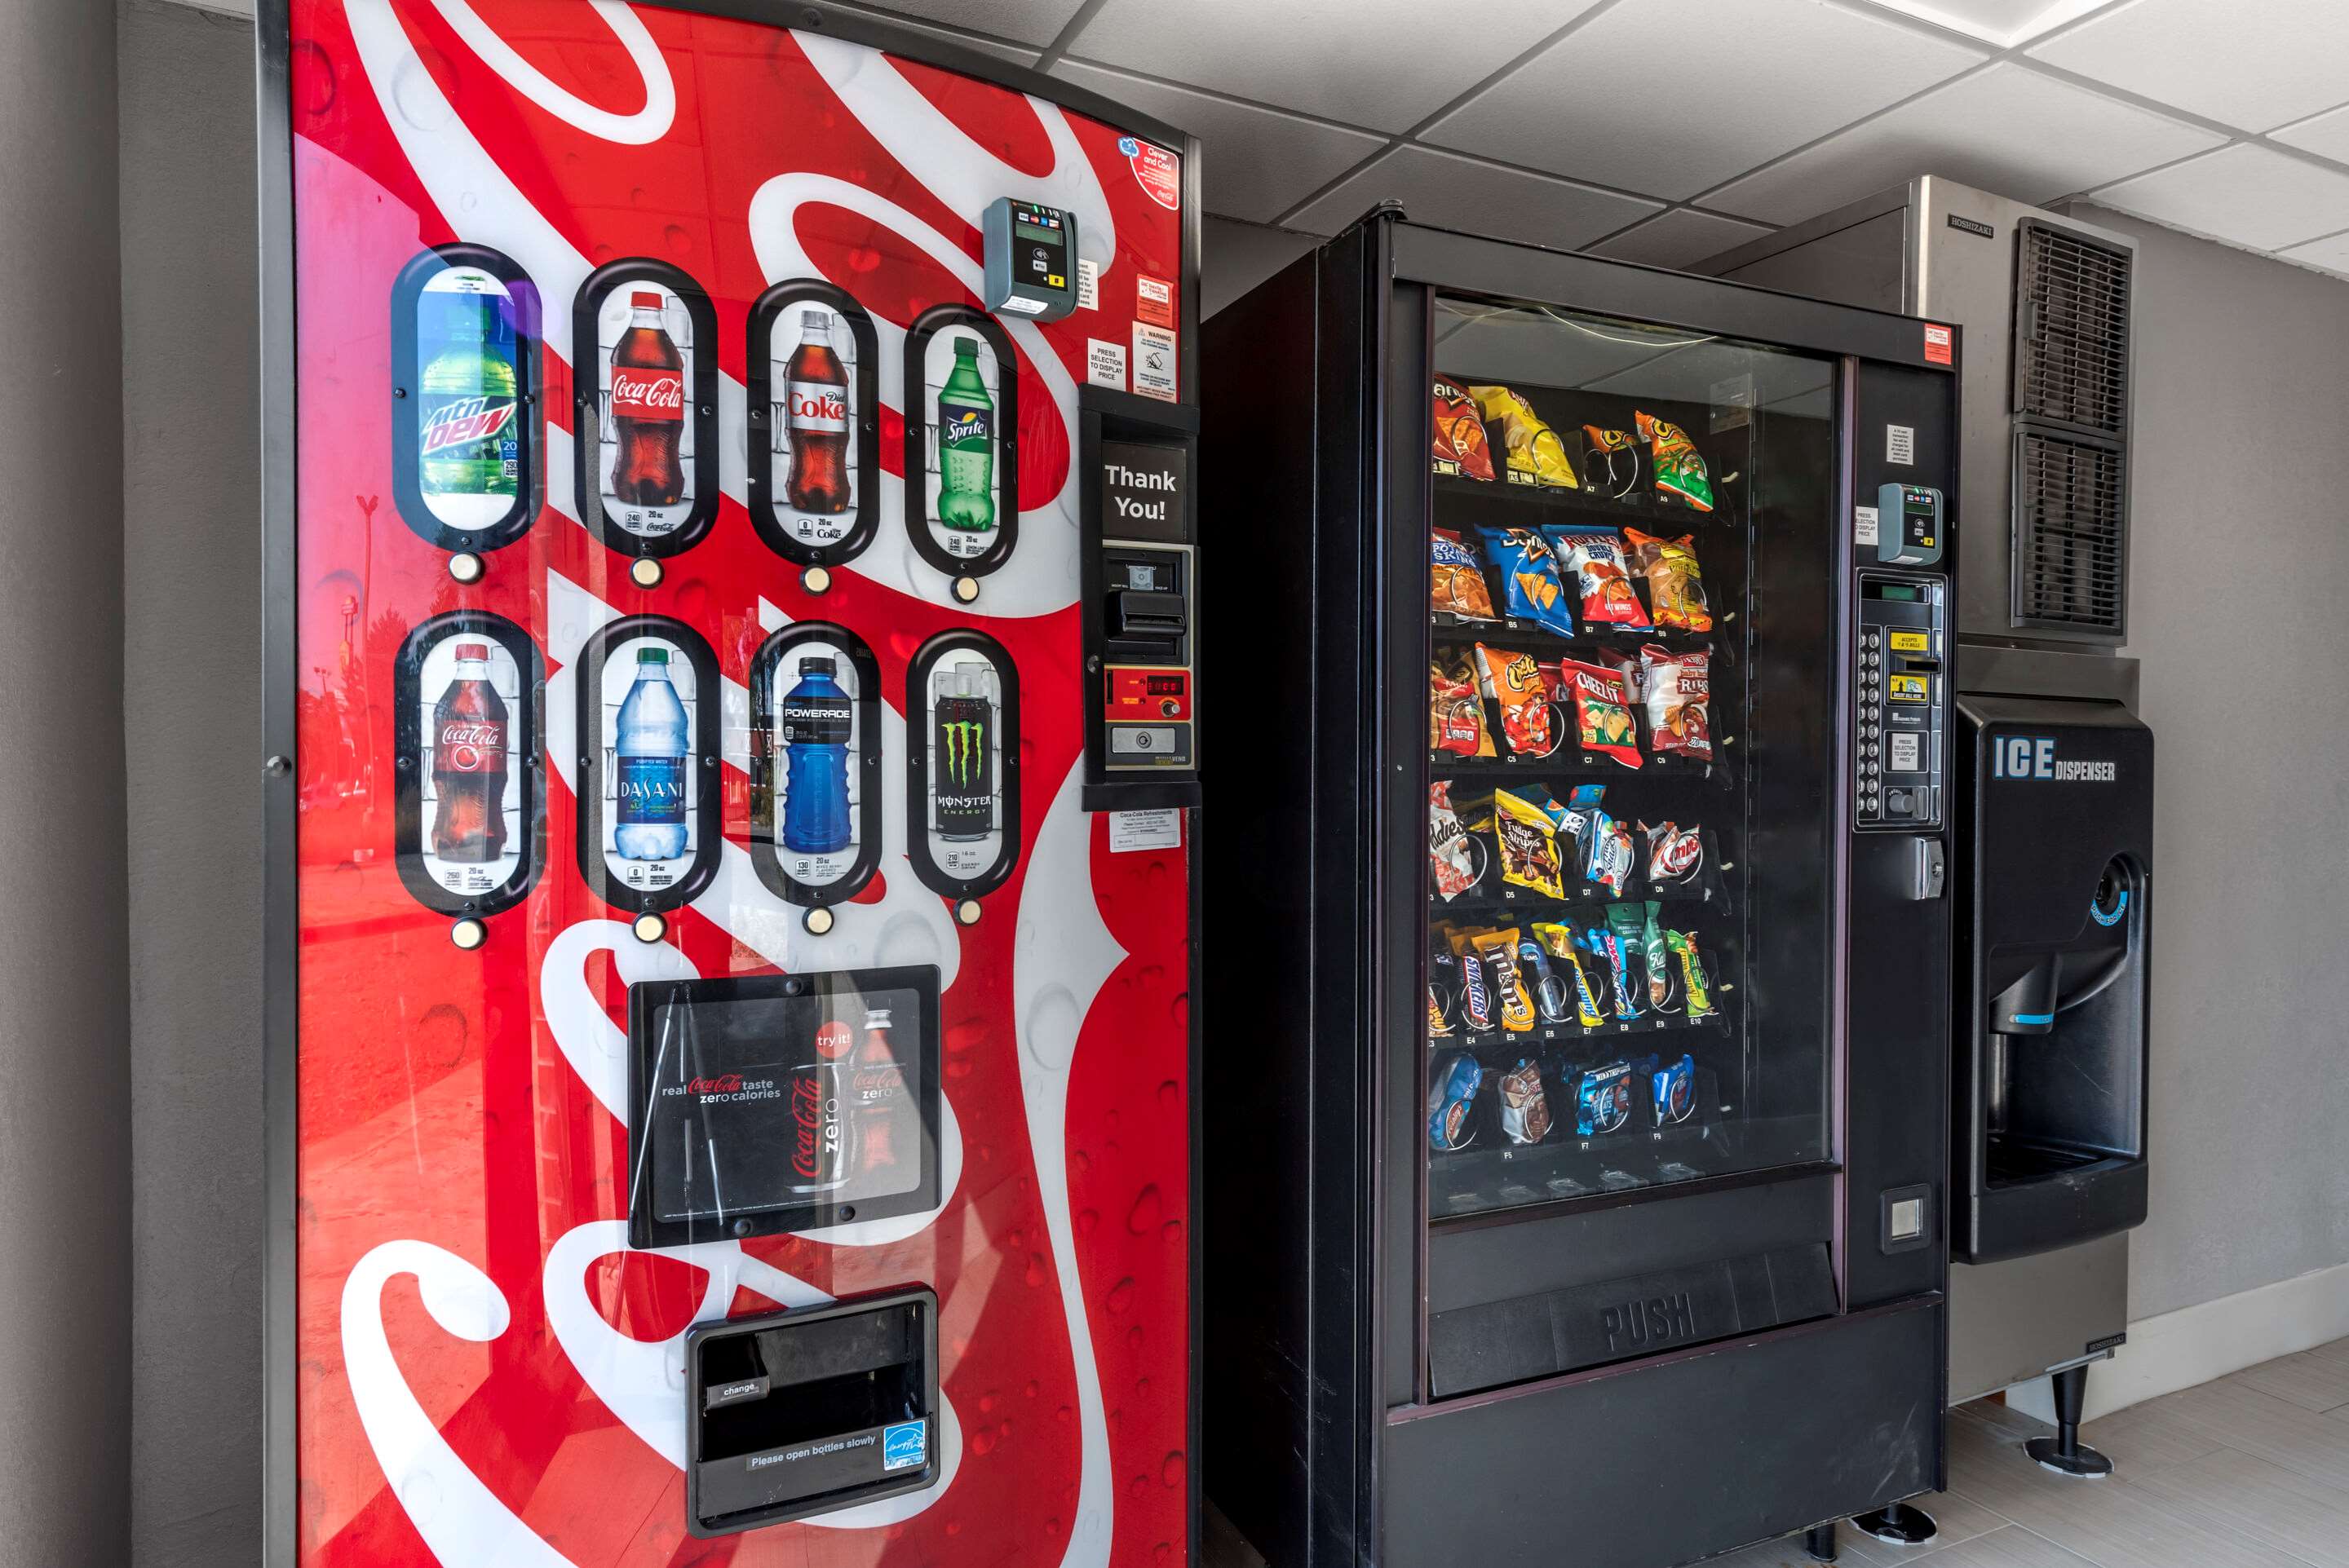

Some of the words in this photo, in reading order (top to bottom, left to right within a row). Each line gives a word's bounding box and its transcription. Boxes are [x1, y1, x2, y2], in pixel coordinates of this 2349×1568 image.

[1144, 156, 1157, 166] and
[1157, 160, 1171, 170] Cool
[1951, 216, 1992, 236] HOSHIZAKI
[1148, 331, 1171, 342] WARNING
[1097, 347, 1116, 358] PRESS
[1090, 354, 1122, 367] SELECTION
[1098, 371, 1116, 381] PRICE
[1099, 364, 1123, 374] DISPLAY
[613, 374, 681, 408] Coca-Cola
[826, 391, 846, 402] Diet
[788, 391, 847, 421] Coke
[948, 419, 984, 442] Sprite
[503, 441, 517, 451] 20
[1104, 465, 1176, 492] Thank
[1114, 496, 1166, 521] You!
[627, 514, 640, 522] 240
[817, 528, 842, 539] Coke
[1564, 535, 1622, 552] RUFFLES
[1586, 544, 1614, 554] DOUBLE
[1590, 551, 1616, 563] CRUNCH
[1615, 603, 1632, 612] WINGS
[1681, 679, 1708, 693] RIBS
[785, 709, 851, 718] POWERADE
[442, 725, 500, 744] Coca-Cola
[1994, 737, 2055, 779] ICE
[2055, 760, 2116, 782] DISPENSER
[621, 776, 683, 801] DASANI
[937, 795, 991, 808] MONSTER
[1506, 820, 1533, 838] Fudge
[798, 861, 808, 869] 130
[1466, 956, 1486, 1019] SNICKERS
[817, 1035, 835, 1048] try
[838, 1034, 850, 1045] it!
[661, 1085, 687, 1096] real
[688, 1073, 744, 1094] Coca-Cola
[742, 1079, 773, 1090] taste
[700, 1093, 729, 1104] zero
[731, 1088, 781, 1101] calories
[861, 1088, 893, 1099] zero
[791, 1076, 821, 1177] Coca-Cola
[825, 1098, 839, 1153] zero
[1599, 1292, 1695, 1352] PUSH
[723, 1382, 754, 1397] change
[750, 1453, 784, 1467] Please
[785, 1448, 810, 1461] open
[812, 1441, 844, 1455] bottles
[846, 1434, 876, 1448] slowly
